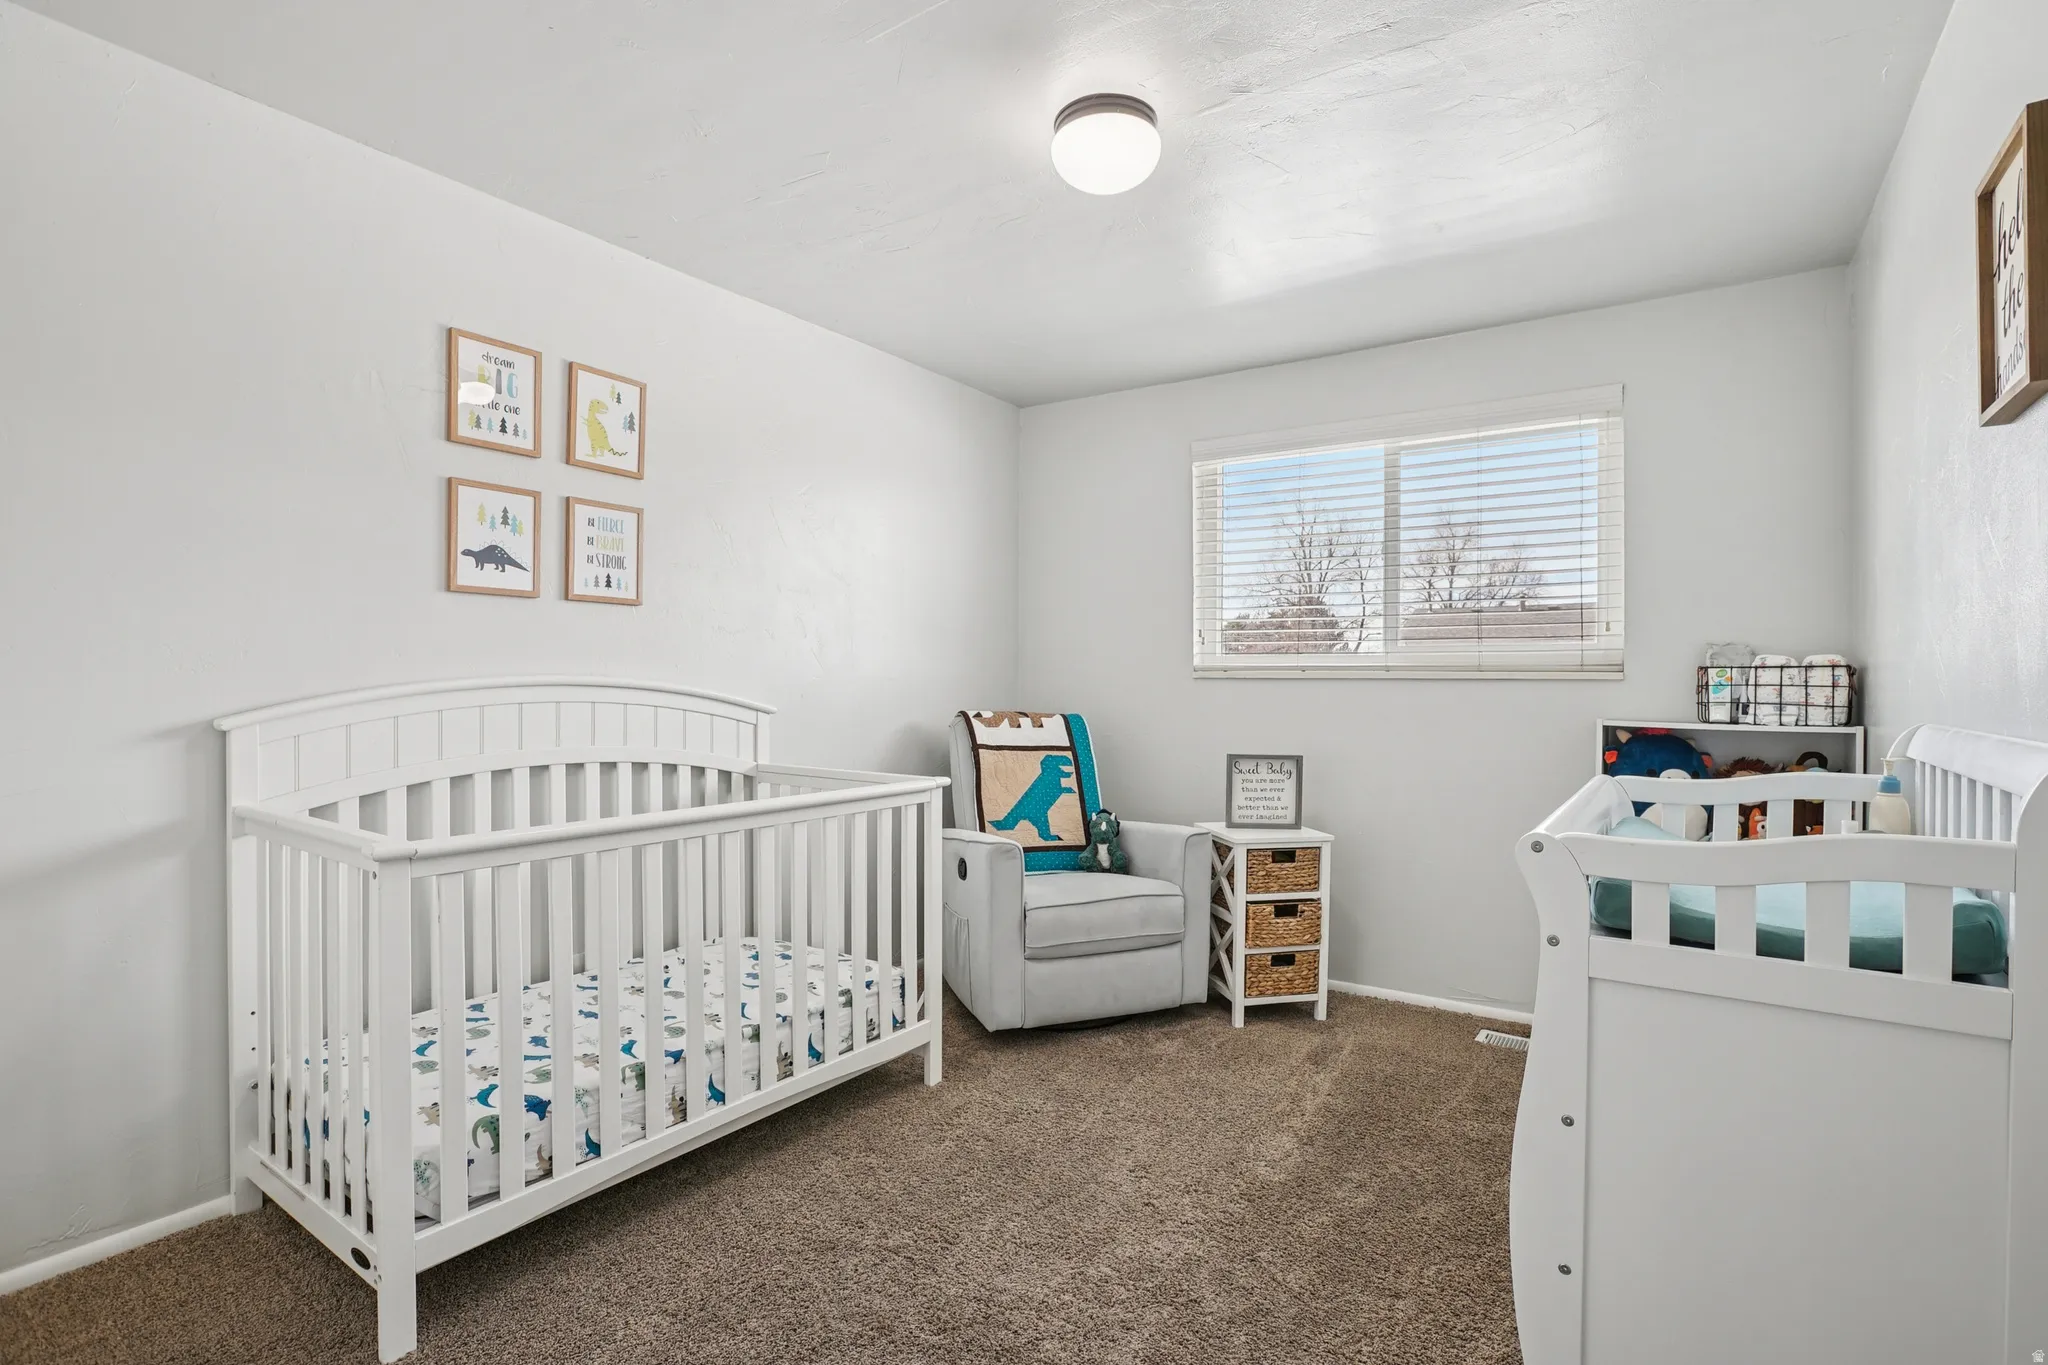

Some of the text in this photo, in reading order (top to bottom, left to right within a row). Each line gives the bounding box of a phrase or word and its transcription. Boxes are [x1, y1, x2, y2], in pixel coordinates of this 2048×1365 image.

[2002, 264, 2024, 338] the
[481, 351, 515, 369] dream
[1994, 325, 2025, 400] hands
[503, 404, 520, 416] one
[597, 516, 625, 535] FIERCE
[596, 534, 624, 552] BRAVE
[595, 552, 627, 571] STRONG
[1233, 760, 1292, 780] Sweet Baby
[1244, 795, 1275, 803] expected
[1255, 813, 1288, 821] imagined
